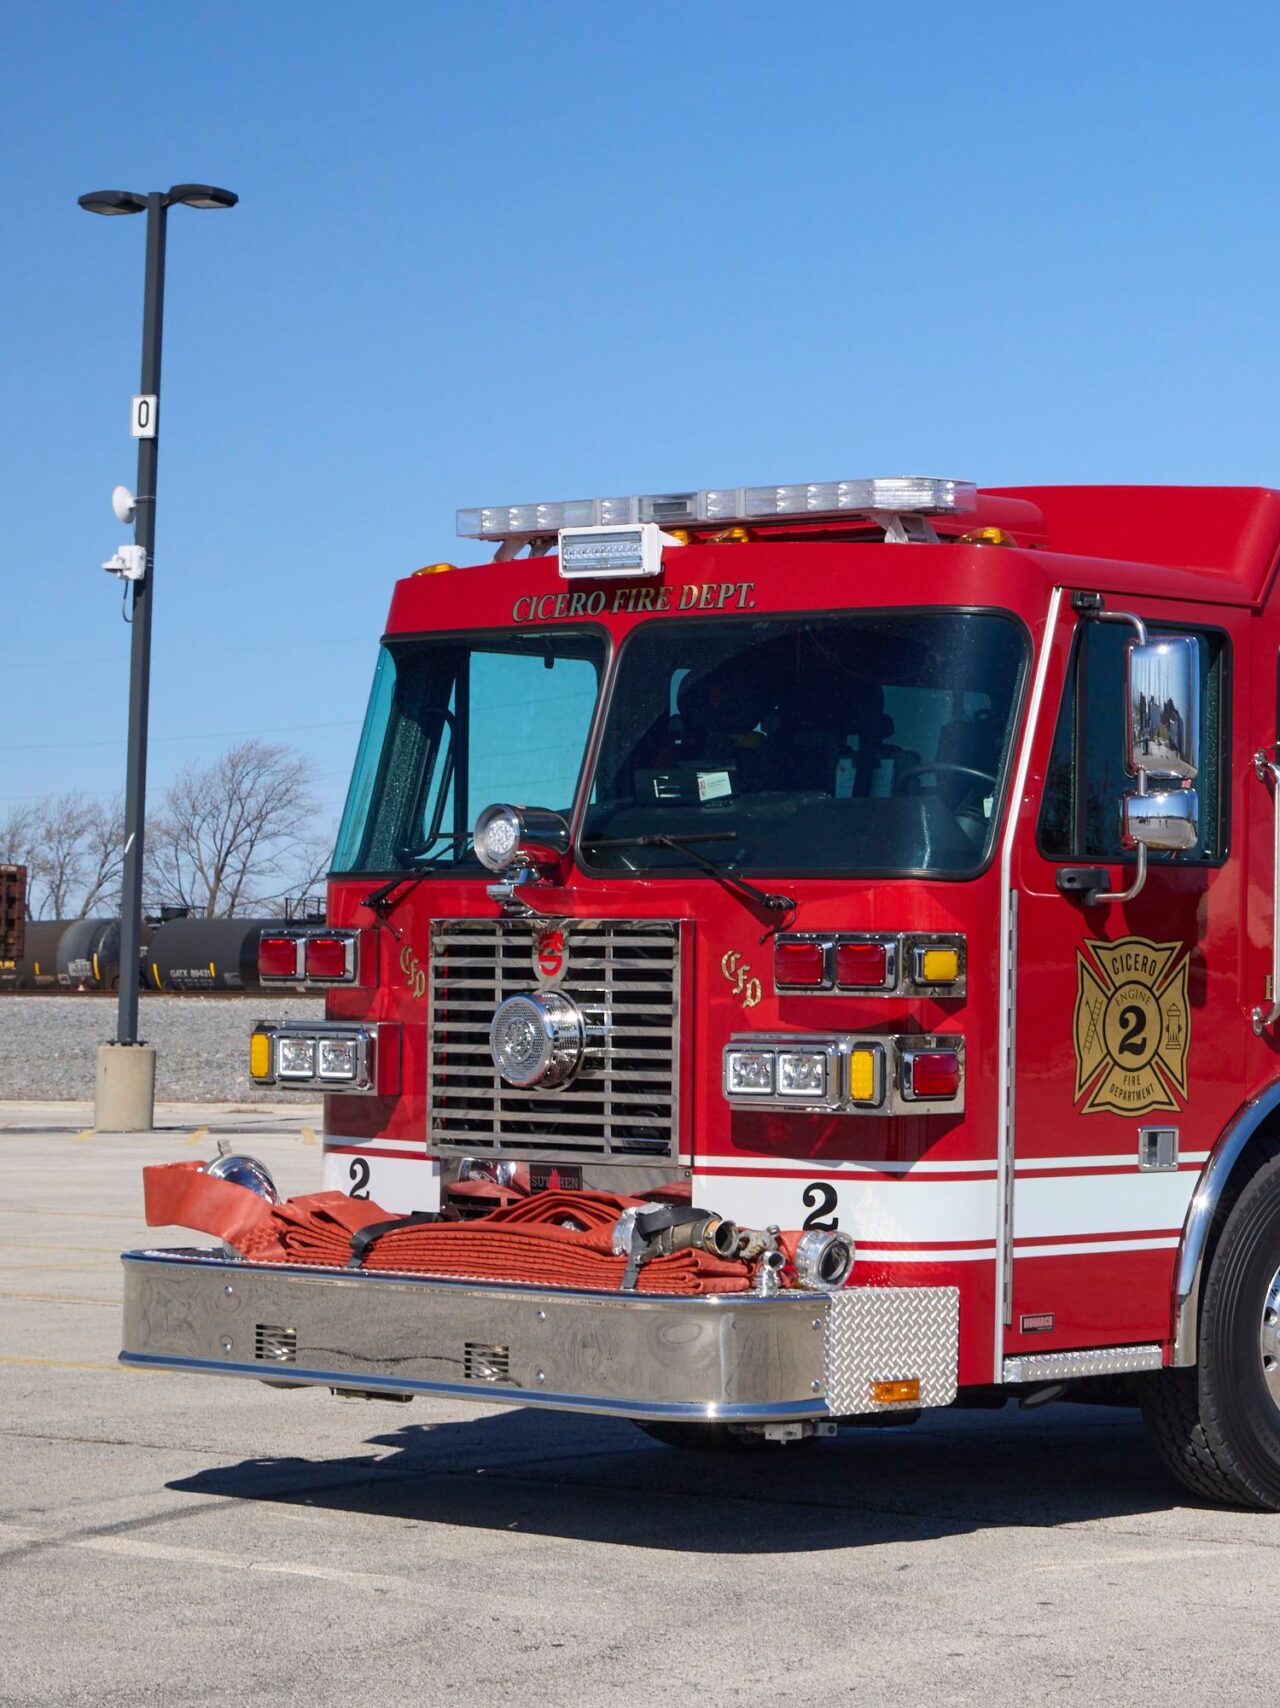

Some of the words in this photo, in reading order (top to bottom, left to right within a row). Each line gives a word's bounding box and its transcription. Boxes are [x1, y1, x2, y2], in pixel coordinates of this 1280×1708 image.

[512, 590, 606, 622] CICERO
[610, 586, 673, 614] FIRE
[678, 582, 757, 610] DEPT.
[1111, 953, 1157, 977] CICERO
[1115, 988, 1151, 1007] ENGINE
[1118, 1005, 1147, 1056] 2
[1109, 1083, 1155, 1101] DEPARTMENT
[1123, 1075, 1141, 1086] FIRE
[349, 1157, 370, 1200] 2
[803, 1182, 839, 1232] 2
